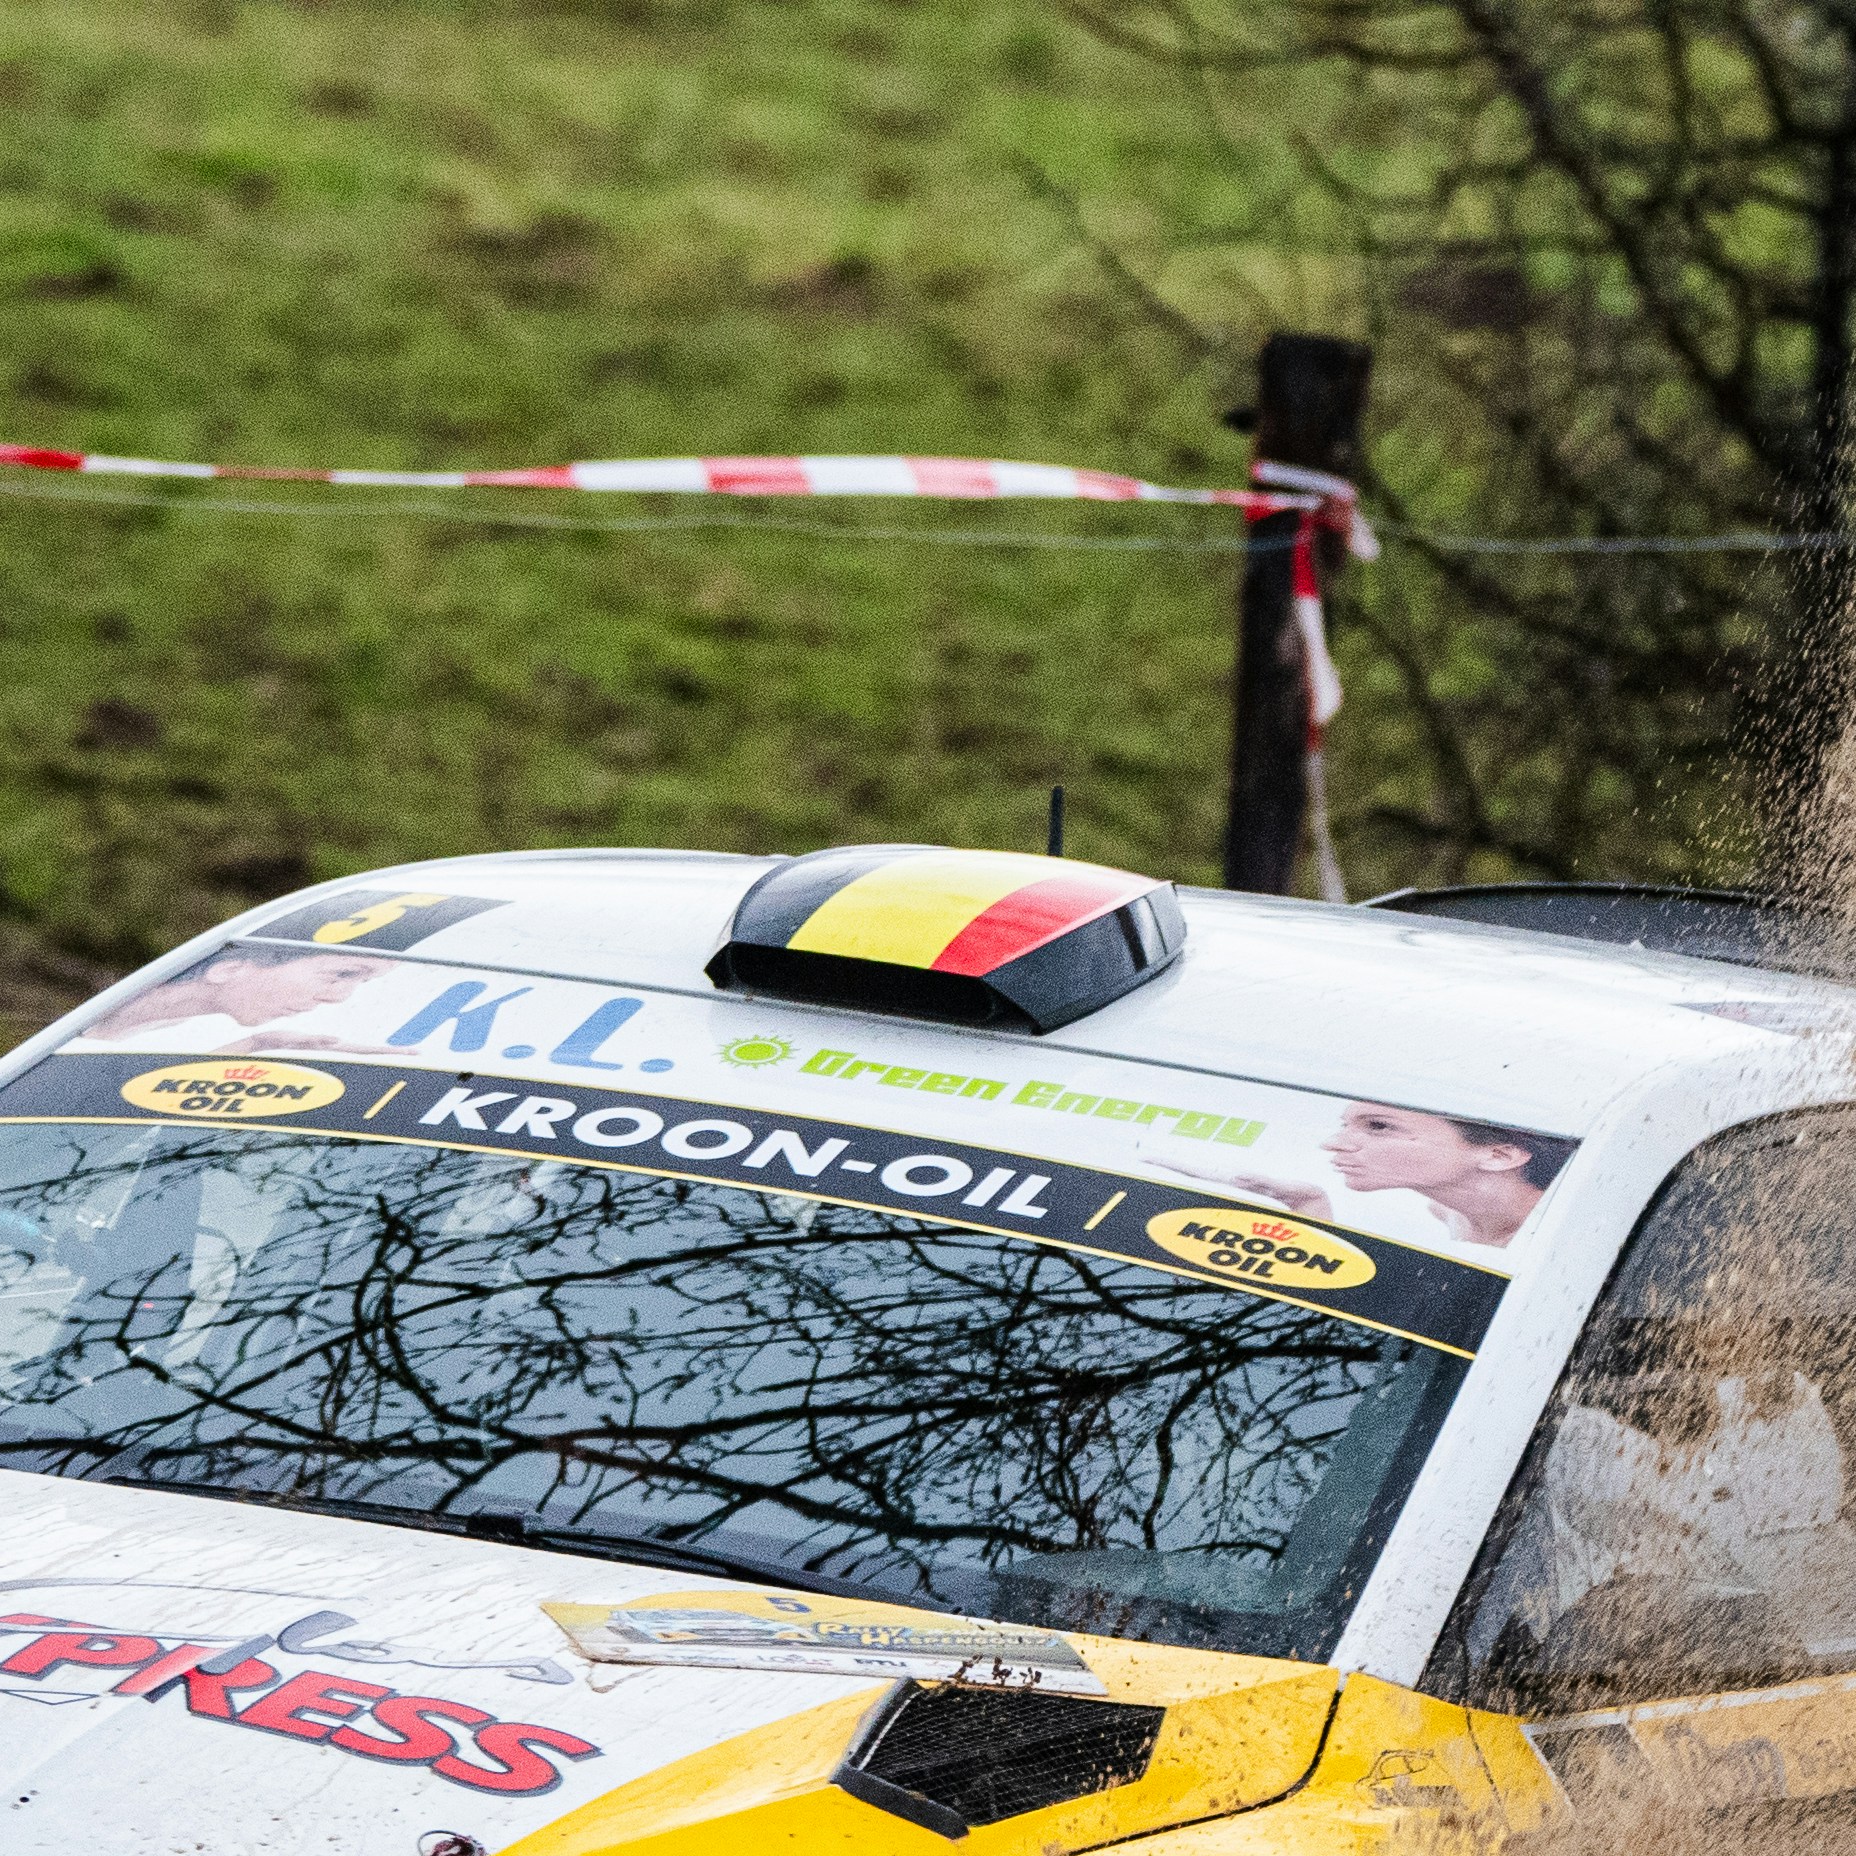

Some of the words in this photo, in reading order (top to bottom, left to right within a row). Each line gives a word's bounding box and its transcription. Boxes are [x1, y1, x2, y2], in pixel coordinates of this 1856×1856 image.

[386, 980, 675, 1073] K.L.
[151, 1078, 313, 1101] KROON
[180, 1096, 246, 1113] OIL
[799, 1047, 1010, 1101] Green
[1011, 1079, 1268, 1148] Energy
[419, 1087, 1053, 1219] KROON-OIL
[1178, 1221, 1345, 1275] KROON
[1208, 1249, 1277, 1278] OIL
[766, 1596, 811, 1613] 5
